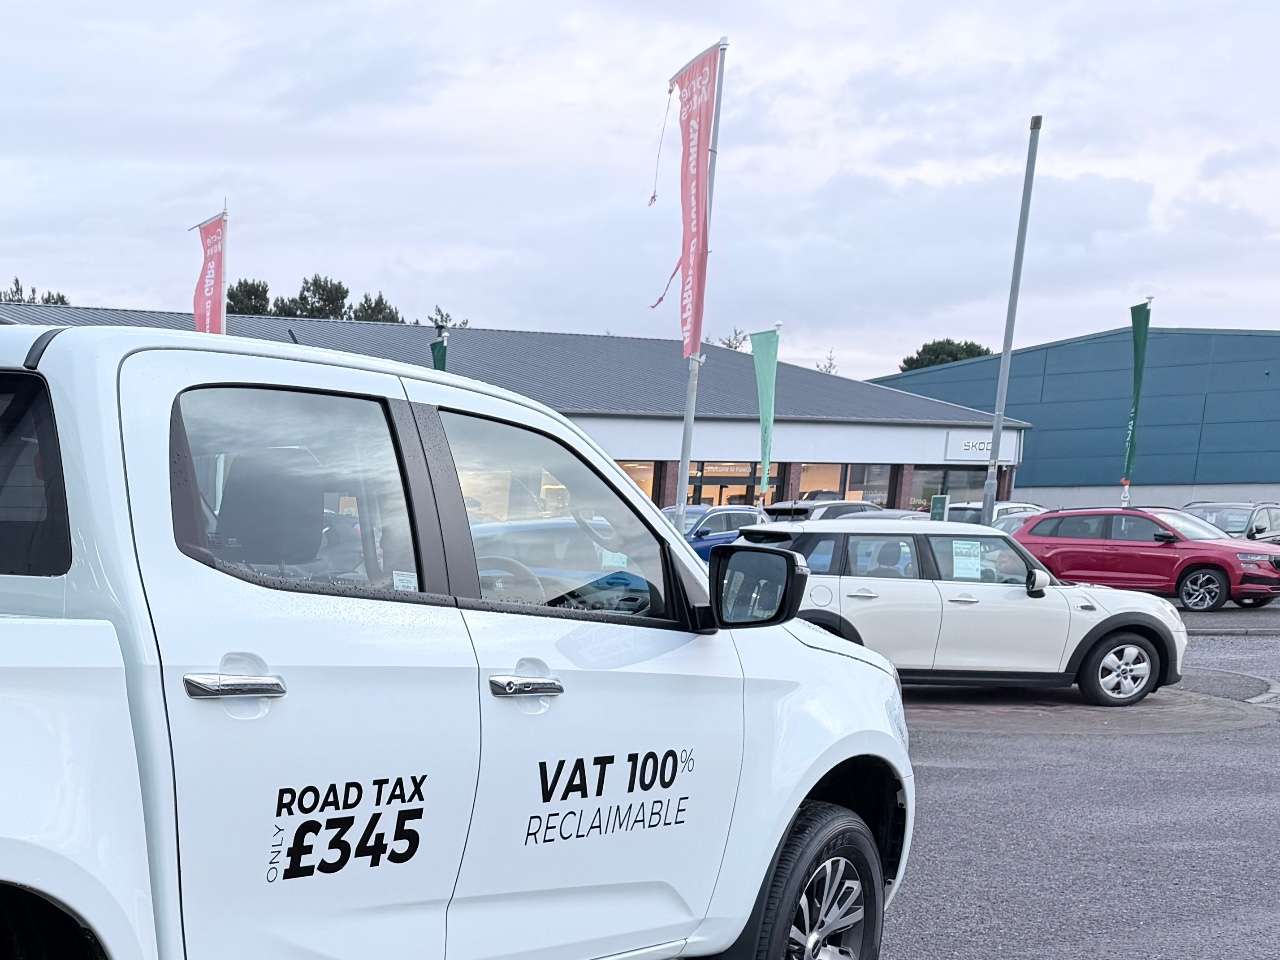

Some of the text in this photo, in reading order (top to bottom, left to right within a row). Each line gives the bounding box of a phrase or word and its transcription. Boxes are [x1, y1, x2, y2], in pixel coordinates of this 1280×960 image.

[275, 774, 428, 817] ROAD TAX
[537, 747, 696, 803] VAT 100%
[282, 807, 425, 880] £345
[524, 796, 690, 846] RECLAIMABLE
[266, 824, 286, 883] ONLY
